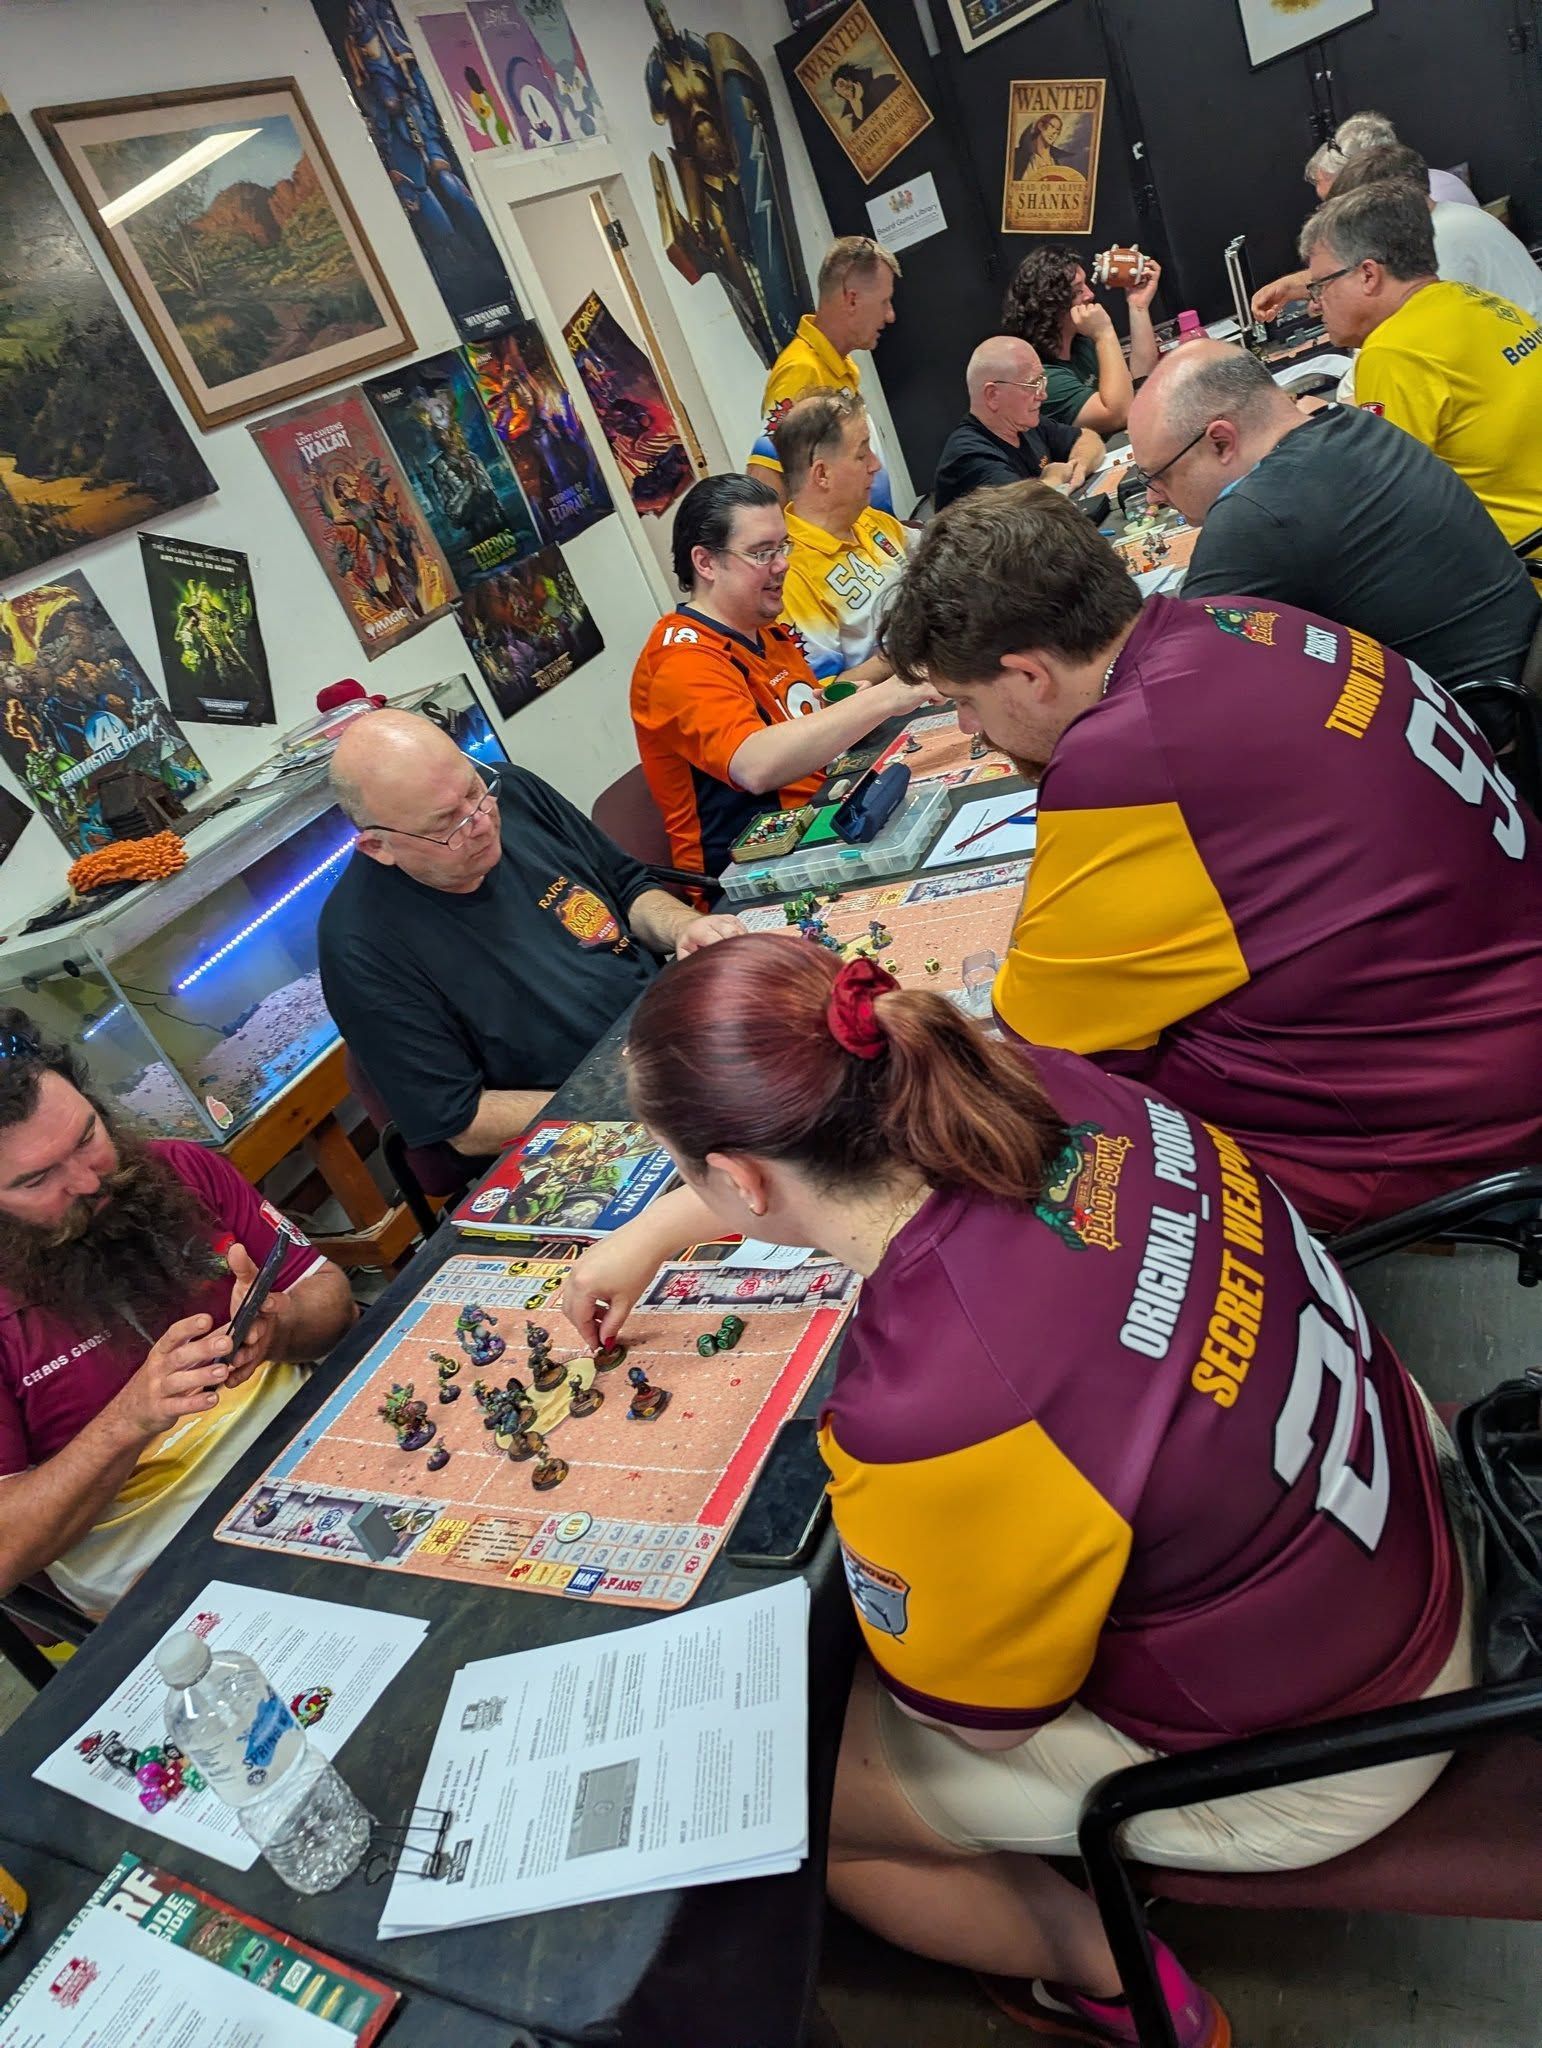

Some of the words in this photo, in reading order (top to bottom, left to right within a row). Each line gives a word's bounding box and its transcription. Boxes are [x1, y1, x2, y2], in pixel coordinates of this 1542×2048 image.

[801, 12, 867, 85] WANTED
[1014, 86, 1098, 111] WANTED
[1017, 193, 1081, 211] SHANKS
[877, 223, 897, 235] Board
[896, 215, 915, 227] Game
[914, 203, 938, 218] Library
[295, 433, 314, 447] LOST
[315, 421, 344, 439] CAVERNS
[300, 429, 352, 464] IXALAN
[152, 543, 164, 552] THE
[166, 545, 190, 557] GALAXY
[160, 554, 174, 562] AND
[174, 556, 195, 567] SHALL
[195, 560, 205, 568] BE
[205, 562, 214, 570] SO
[468, 529, 516, 565] THEROS
[825, 551, 885, 610] 54
[374, 606, 412, 633] MAGIC
[662, 626, 700, 647] 18
[1304, 624, 1338, 664] GIBBSY
[1324, 669, 1385, 740] THROW
[60, 744, 118, 788] FANTASTIC
[1094, 1134, 1134, 1187] BOWL
[613, 1174, 661, 1216] BOWL
[1083, 1183, 1119, 1251] BLOOD
[1191, 1248, 1265, 1409] SECRET
[590, 1525, 603, 1539] 2
[609, 1526, 620, 1541] 3
[632, 1528, 645, 1544] 4
[653, 1530, 669, 1545] 5
[675, 1530, 690, 1546] 6
[551, 1545, 564, 1559] 1
[571, 1548, 586, 1561] 2
[594, 1549, 607, 1563] 3
[618, 1551, 630, 1566] 4
[639, 1553, 654, 1569] 5
[661, 1553, 675, 1569] 6
[536, 1566, 548, 1582] 1
[558, 1569, 573, 1585] 2
[650, 1578, 661, 1595] 1
[669, 1582, 686, 1598] 2
[67, 1863, 127, 1933] GAMES!
